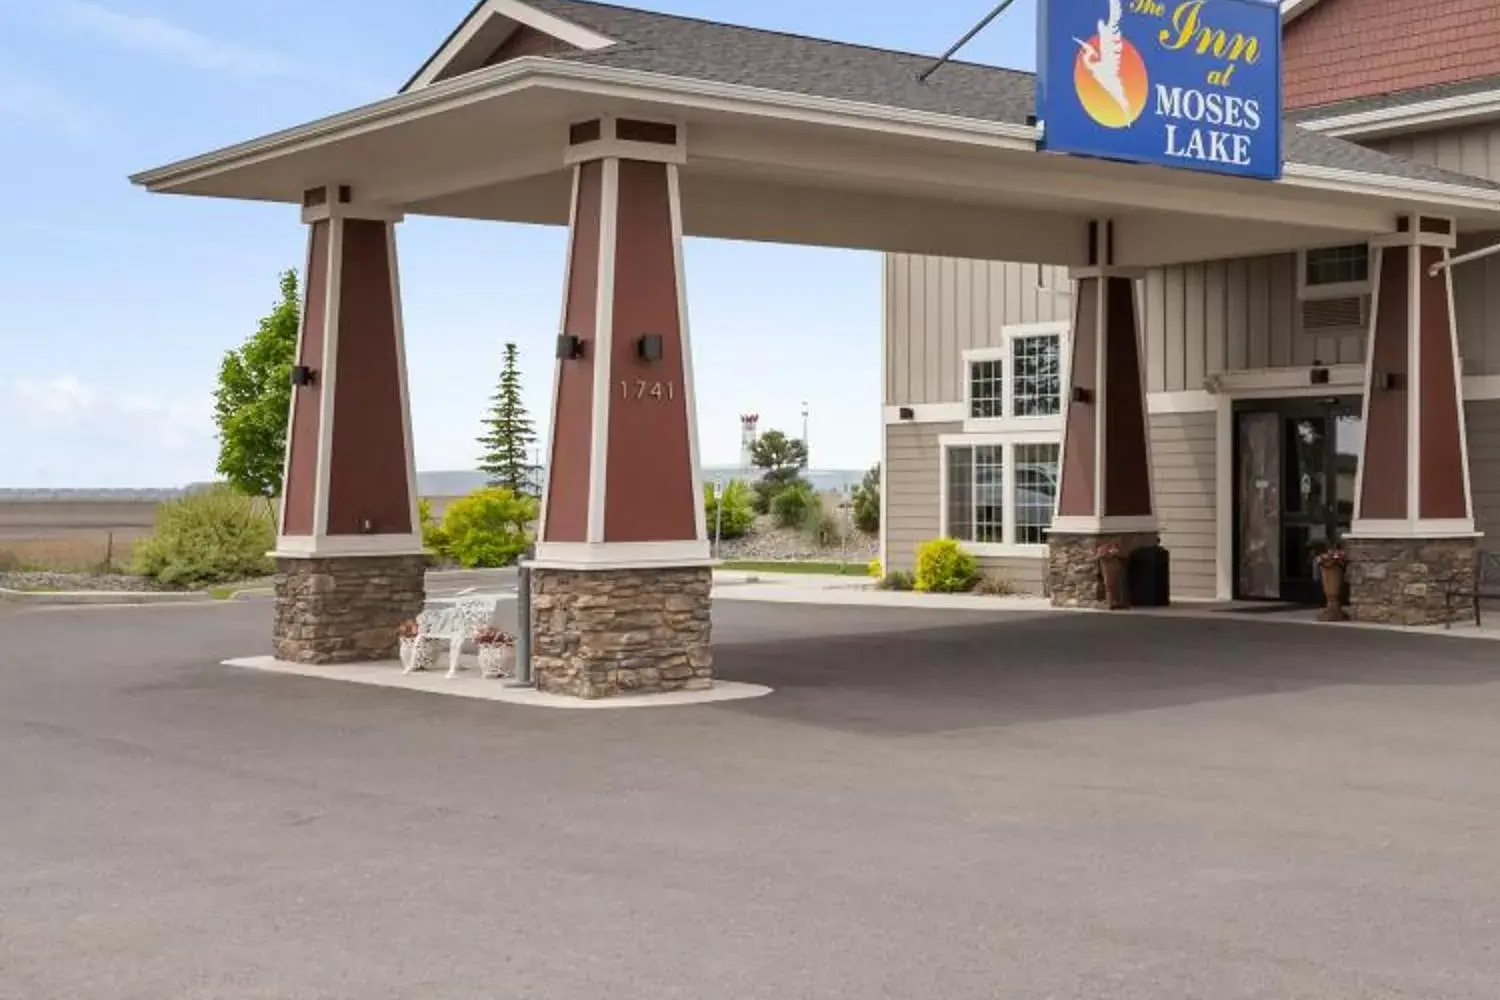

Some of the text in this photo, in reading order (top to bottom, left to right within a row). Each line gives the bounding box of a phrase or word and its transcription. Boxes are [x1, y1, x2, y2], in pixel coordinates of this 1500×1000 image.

[1159, 0, 1260, 65] Inn
[1207, 63, 1235, 87] at
[1155, 83, 1261, 131] MOSES
[1164, 124, 1251, 166] LAKE
[620, 379, 674, 400] 1741
